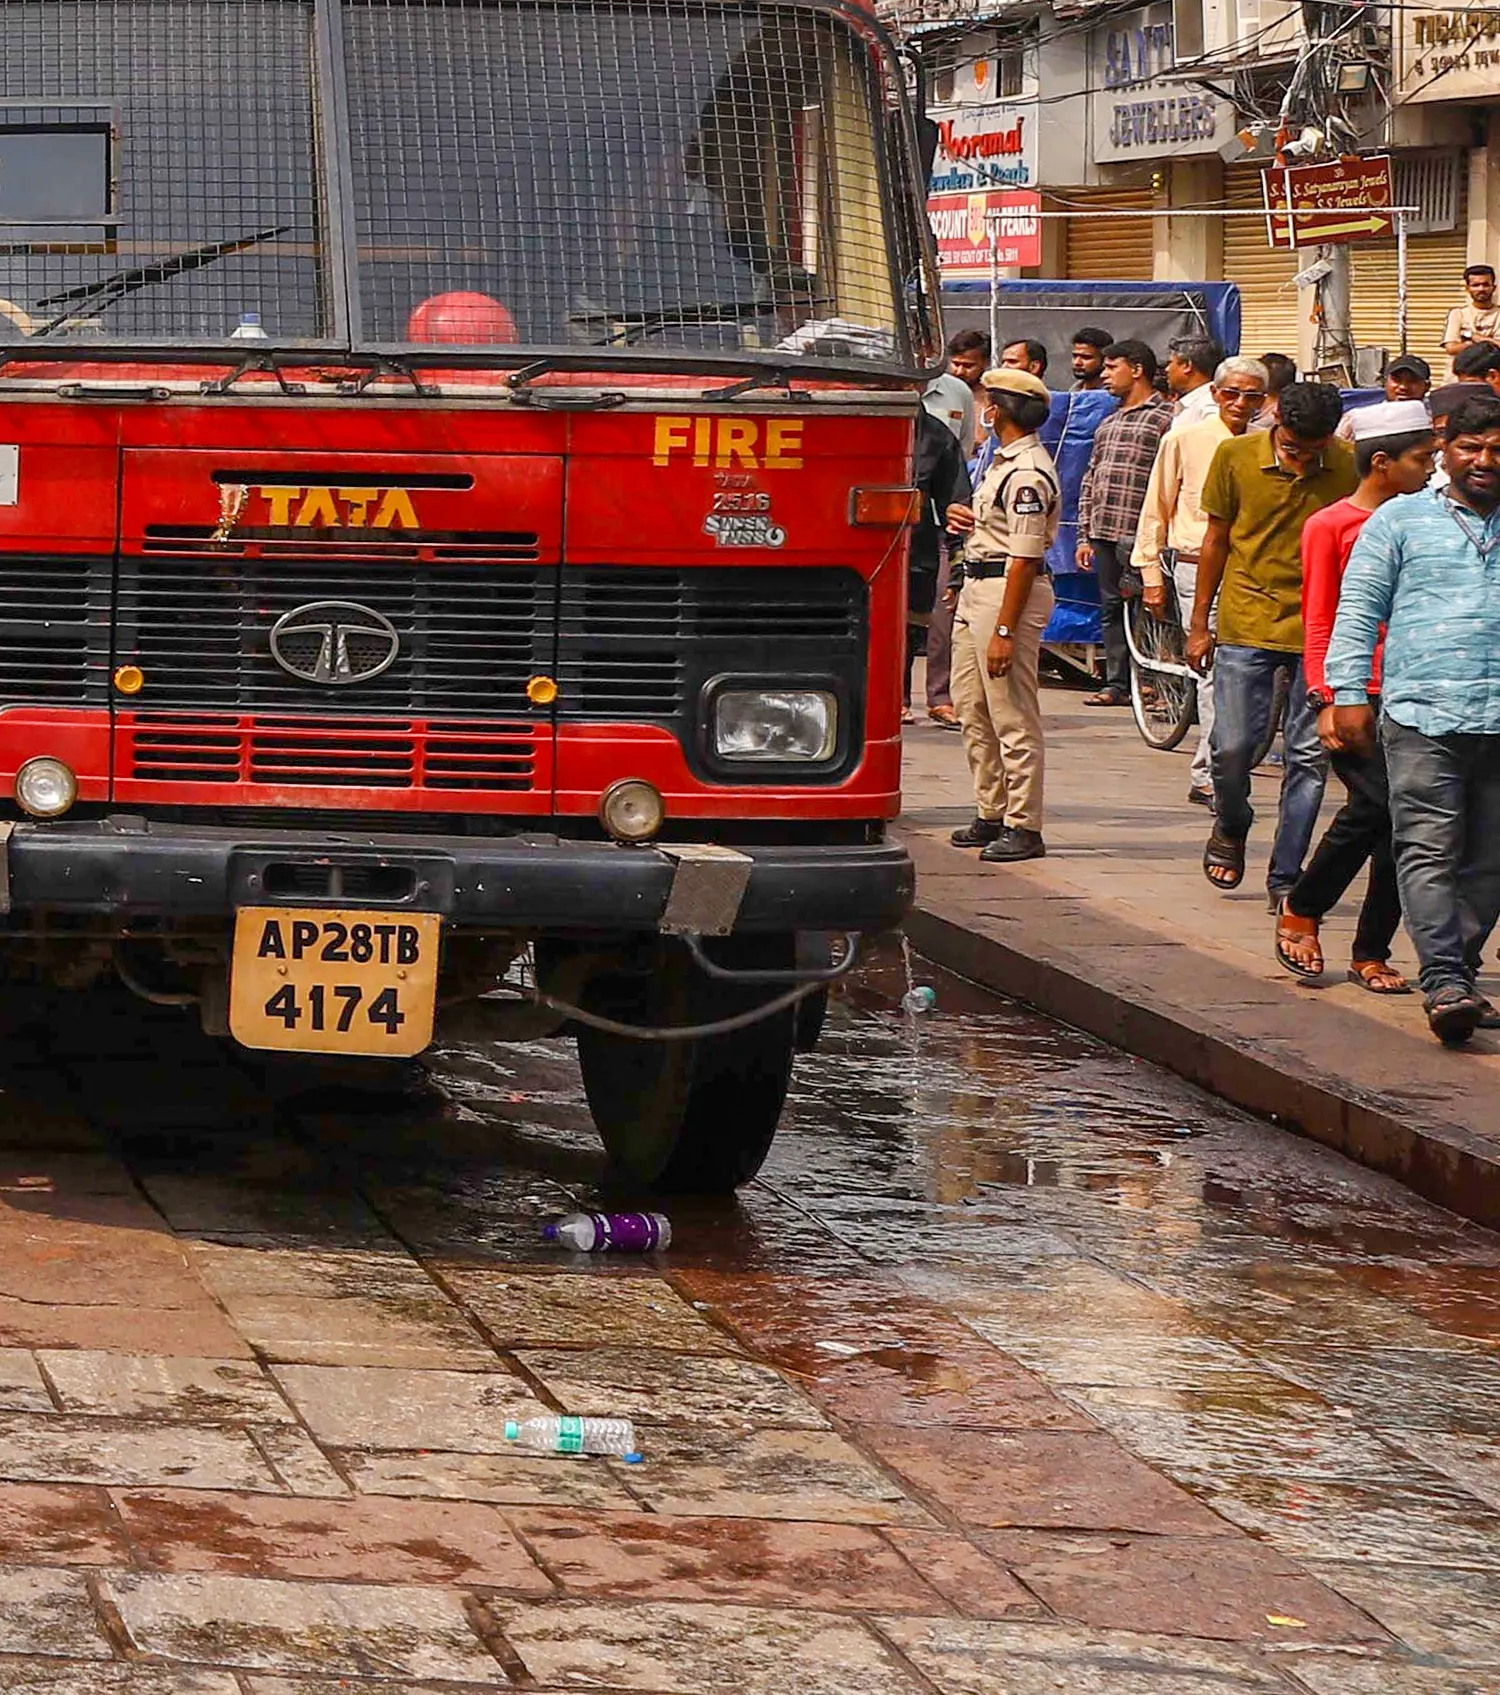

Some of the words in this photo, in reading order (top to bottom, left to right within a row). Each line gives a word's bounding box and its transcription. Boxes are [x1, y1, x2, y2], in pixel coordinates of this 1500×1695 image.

[1360, 170, 1387, 190] Jewels
[1001, 205, 1037, 237] PEARLS
[653, 416, 804, 469] FIRE
[260, 487, 419, 529] TATA
[713, 492, 771, 511] 2516
[257, 920, 420, 965] AP28TB
[264, 984, 405, 1034] 4174
